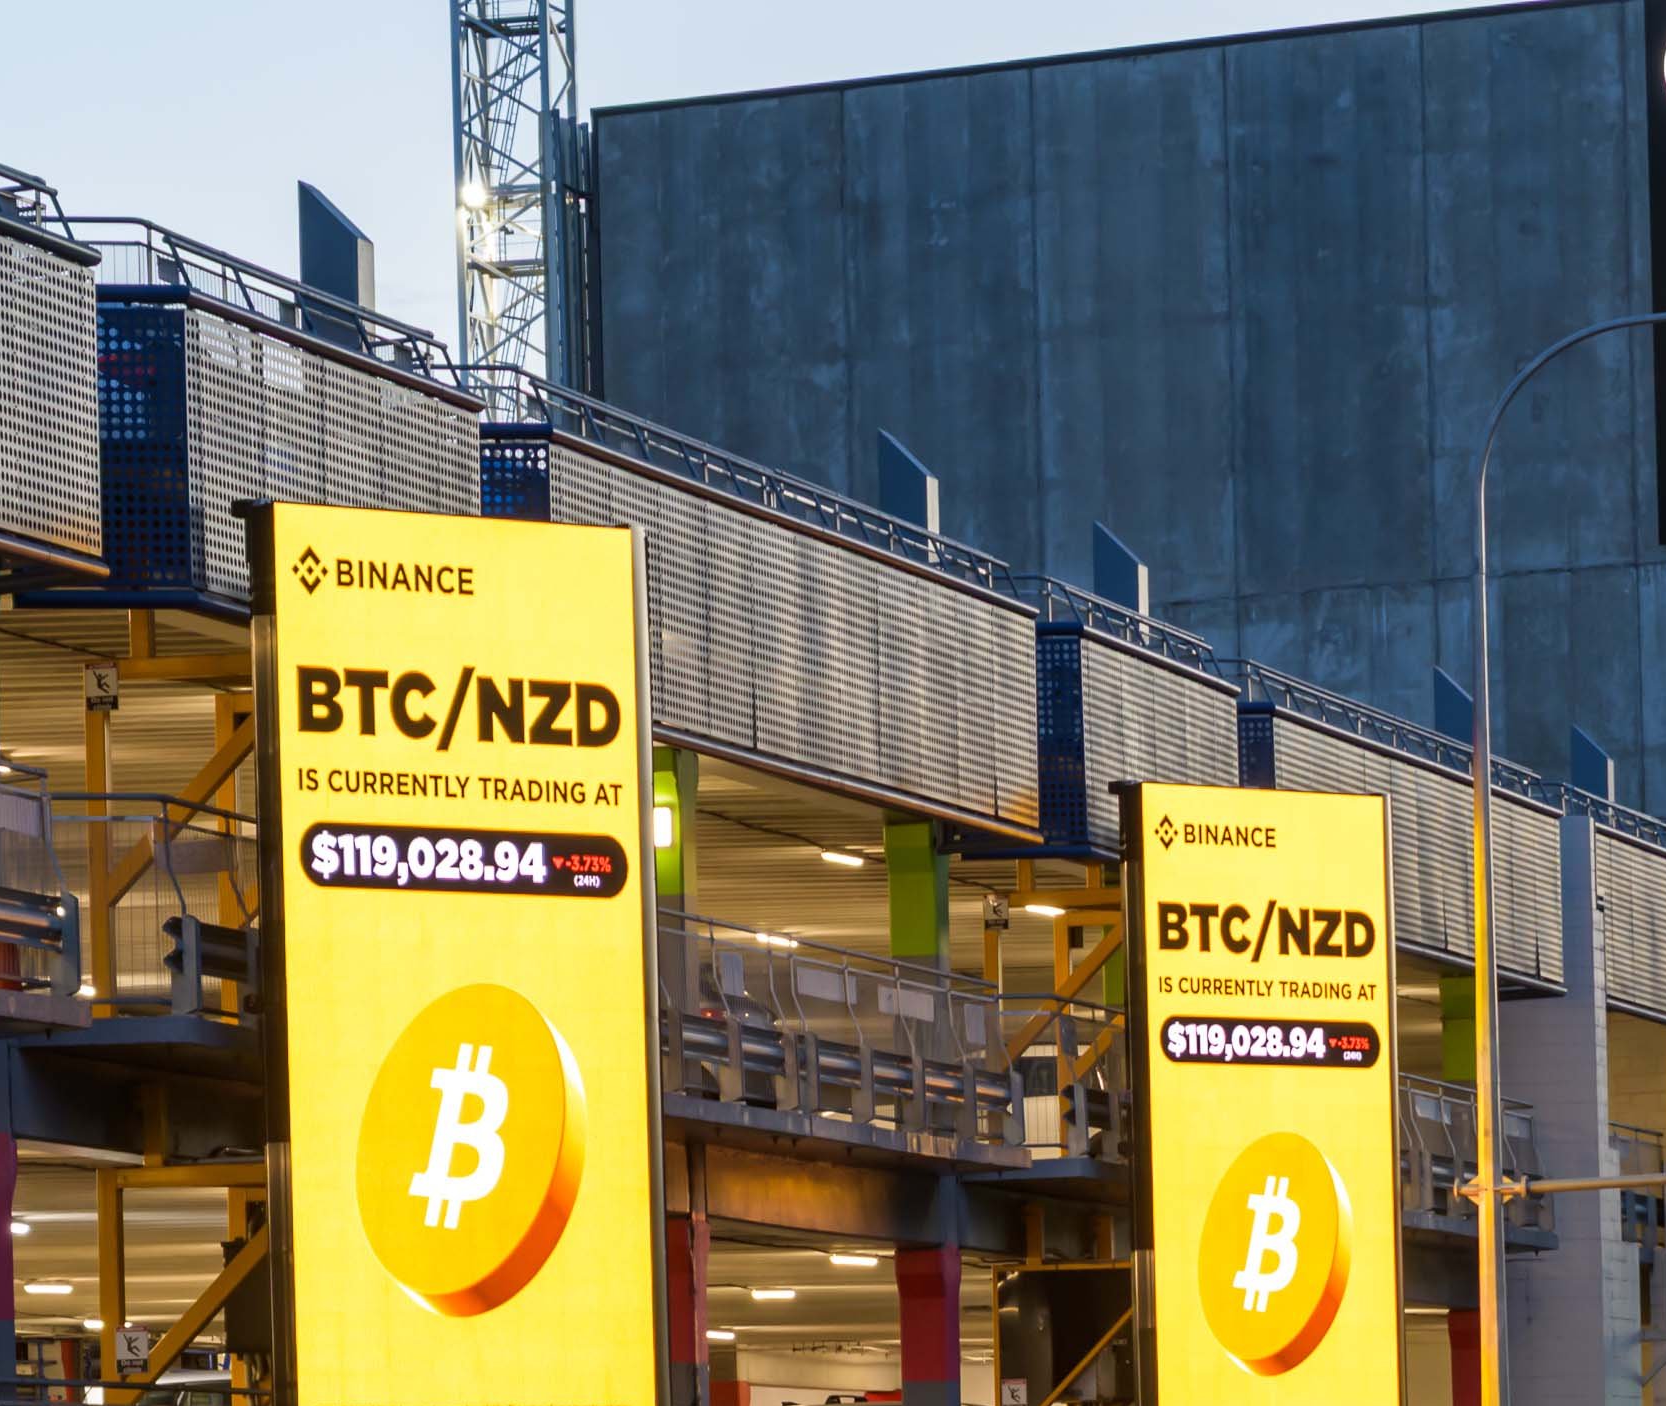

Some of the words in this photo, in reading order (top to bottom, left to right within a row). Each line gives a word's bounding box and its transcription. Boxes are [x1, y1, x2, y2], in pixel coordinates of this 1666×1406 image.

[336, 559, 474, 595] BINANCE
[296, 664, 621, 752] BTC/NZD
[298, 768, 319, 791] IS
[328, 769, 470, 799] CURRENTLY
[479, 778, 586, 804] TRADING
[594, 784, 623, 806] AT
[1184, 824, 1277, 848] BINANCE
[311, 830, 548, 885] $119,028.94
[573, 874, 601, 888] (24H)
[1158, 900, 1376, 963] BTC/NZD
[1159, 976, 1173, 993] IS
[1179, 977, 1274, 997] CURRENTLY
[1279, 981, 1352, 1000] TRADING
[1357, 984, 1377, 1001] AT
[1167, 1021, 1326, 1061] $119,028.94
